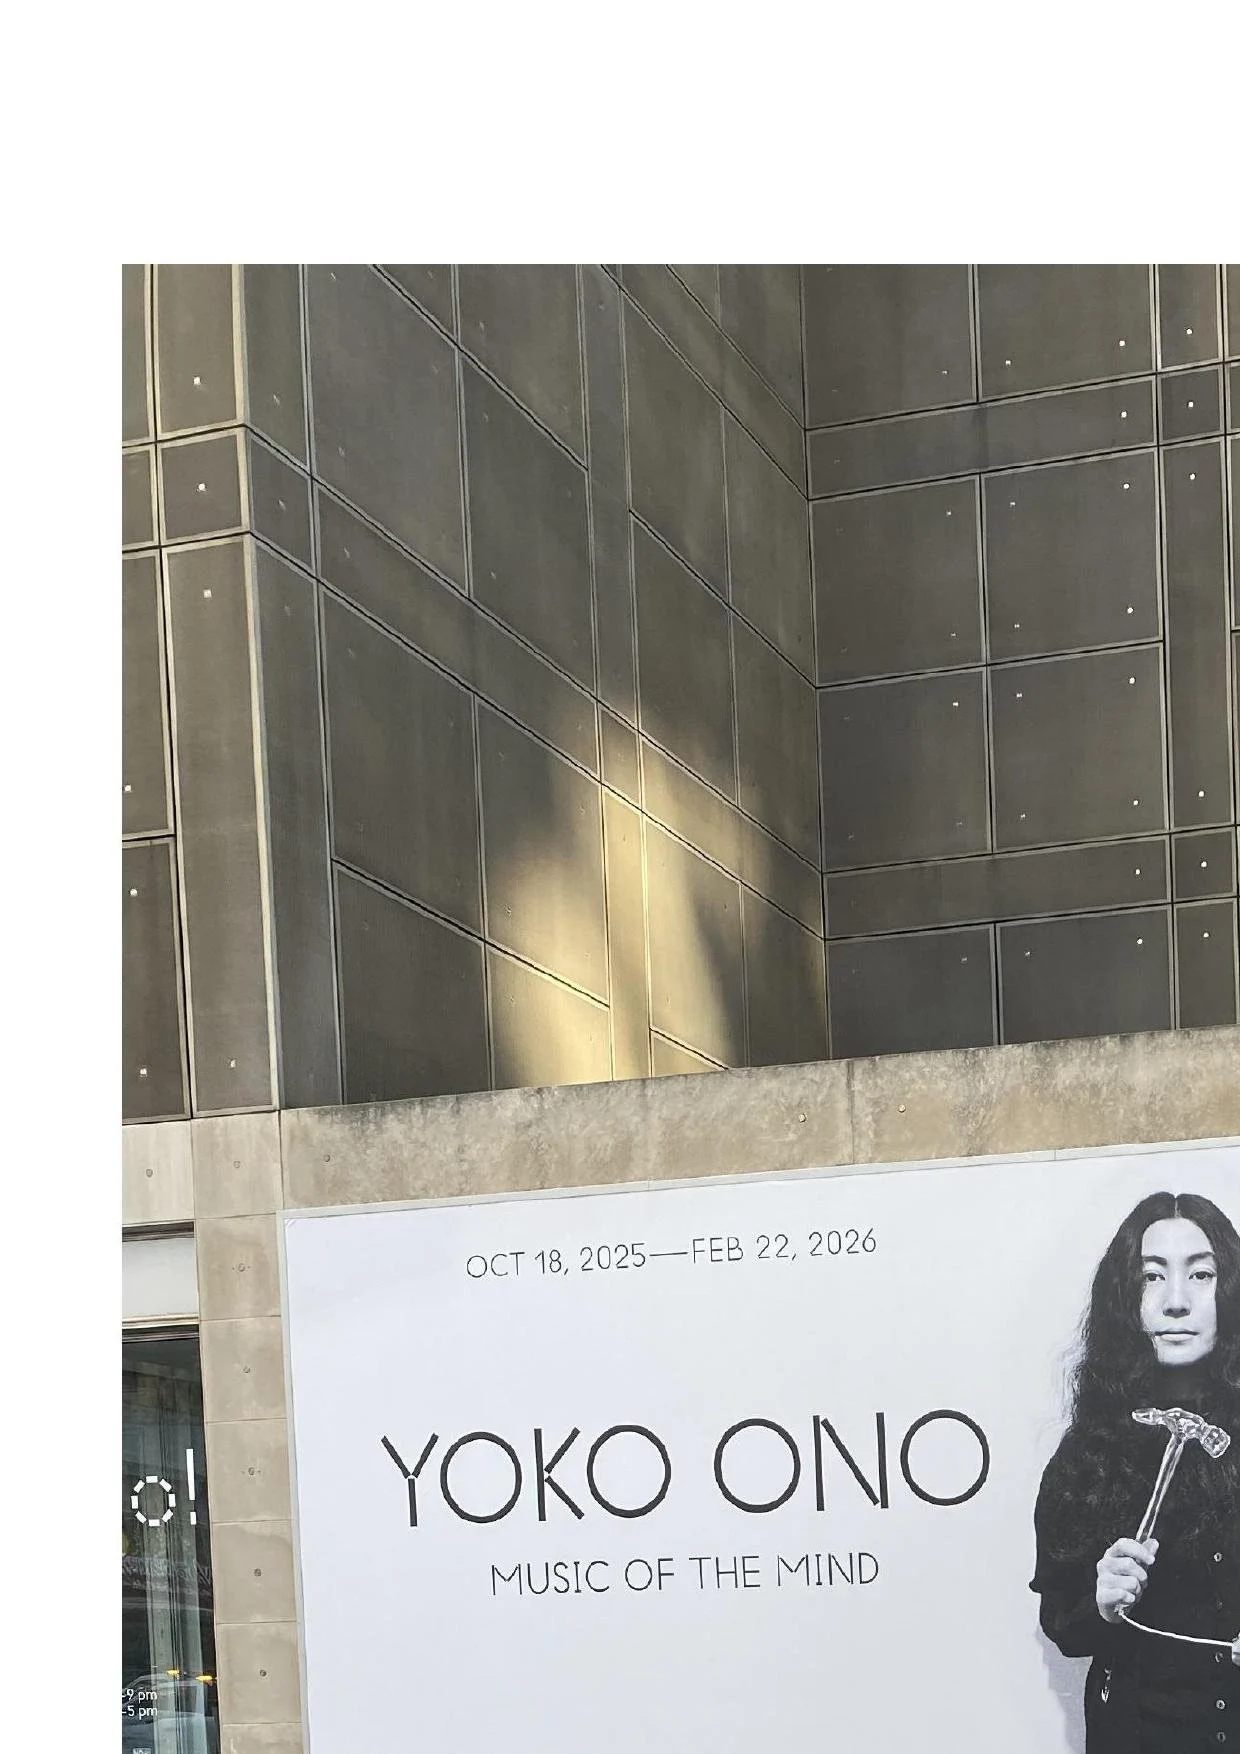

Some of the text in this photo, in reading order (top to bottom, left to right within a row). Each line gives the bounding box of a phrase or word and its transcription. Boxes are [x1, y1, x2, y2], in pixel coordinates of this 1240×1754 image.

[467, 1251, 526, 1279] OCT
[534, 1248, 569, 1276] 18,
[756, 1233, 797, 1261] 22,
[808, 1227, 877, 1257] 2026
[380, 1408, 991, 1528] YOKO ONO
[491, 1551, 879, 1597] MUSIC OF THE MIND
[138, 1690, 158, 1704] pm
[138, 1707, 158, 1721] pm
